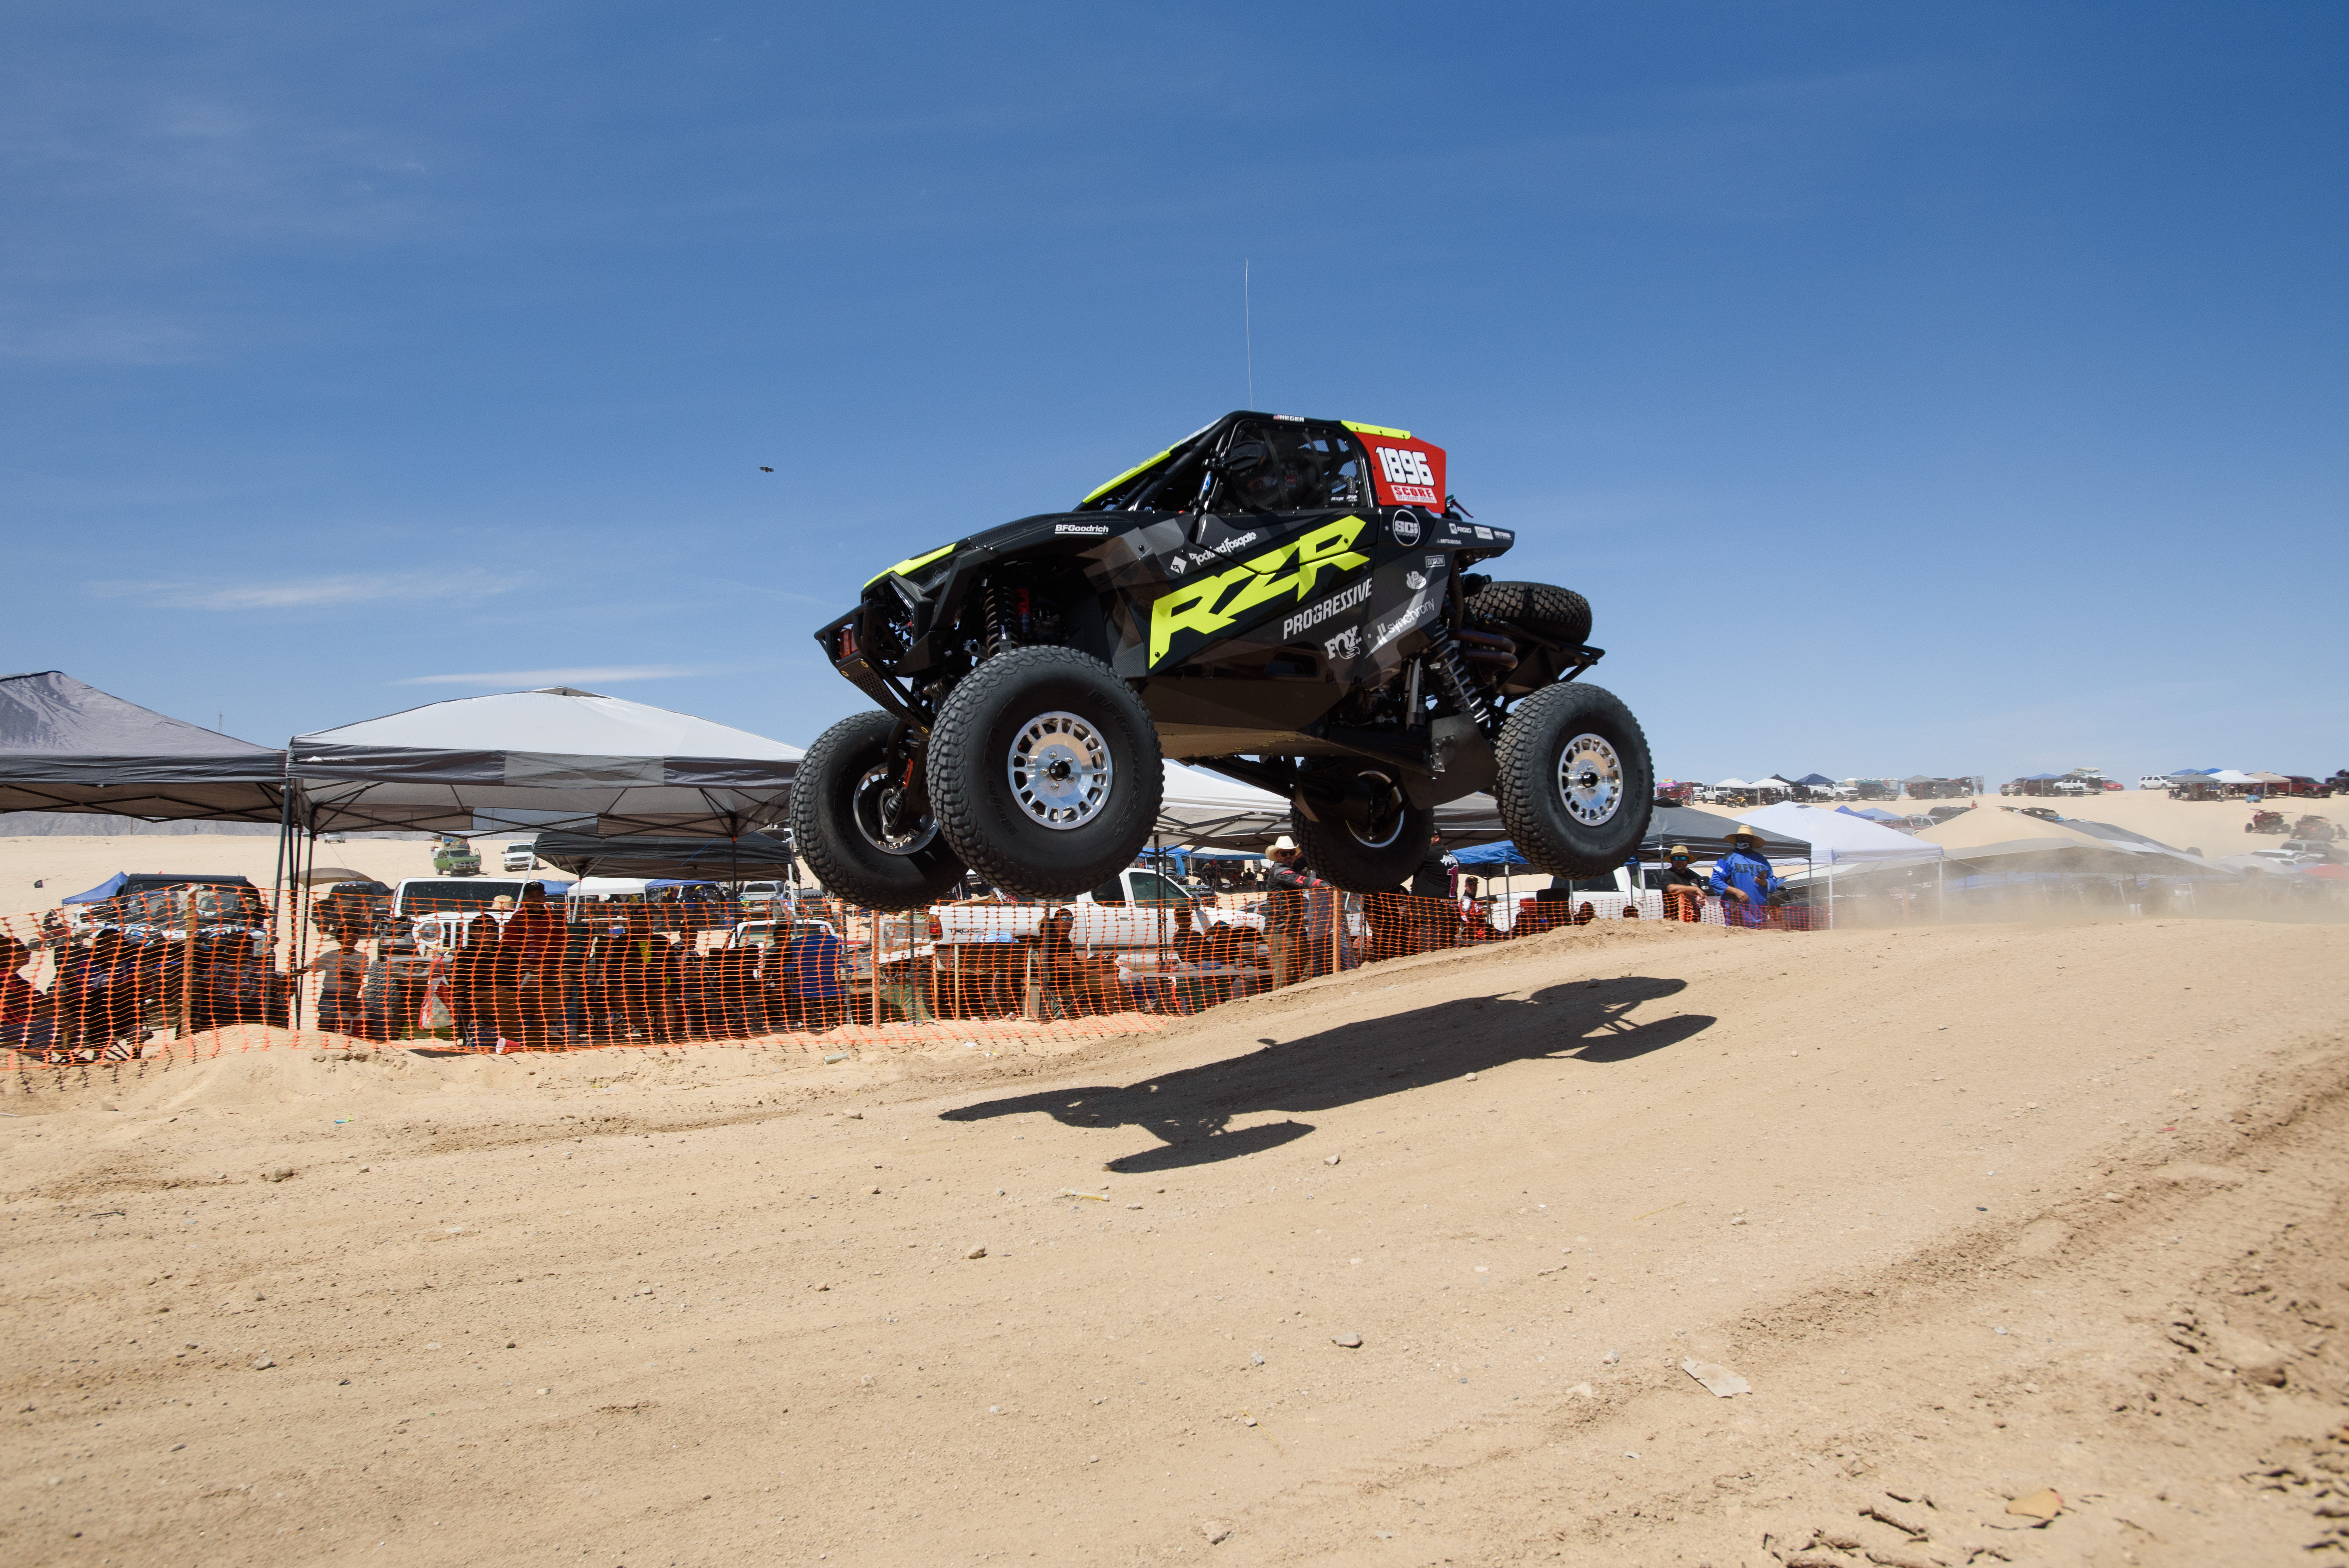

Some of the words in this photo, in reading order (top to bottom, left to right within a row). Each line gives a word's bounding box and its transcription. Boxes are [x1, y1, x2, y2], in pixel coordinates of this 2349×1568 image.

[1375, 446, 1435, 486] 1896
[1394, 486, 1433, 497] SCORE
[1055, 524, 1109, 533] BFGoodrich
[1150, 515, 1370, 669] RZR
[1283, 577, 1372, 640] PROGRESSIVE
[1388, 598, 1435, 633] synchrony
[1324, 625, 1362, 659] FOX
[1087, 690, 1141, 837] BFGoodrich
[1447, 865, 1459, 897] 1
